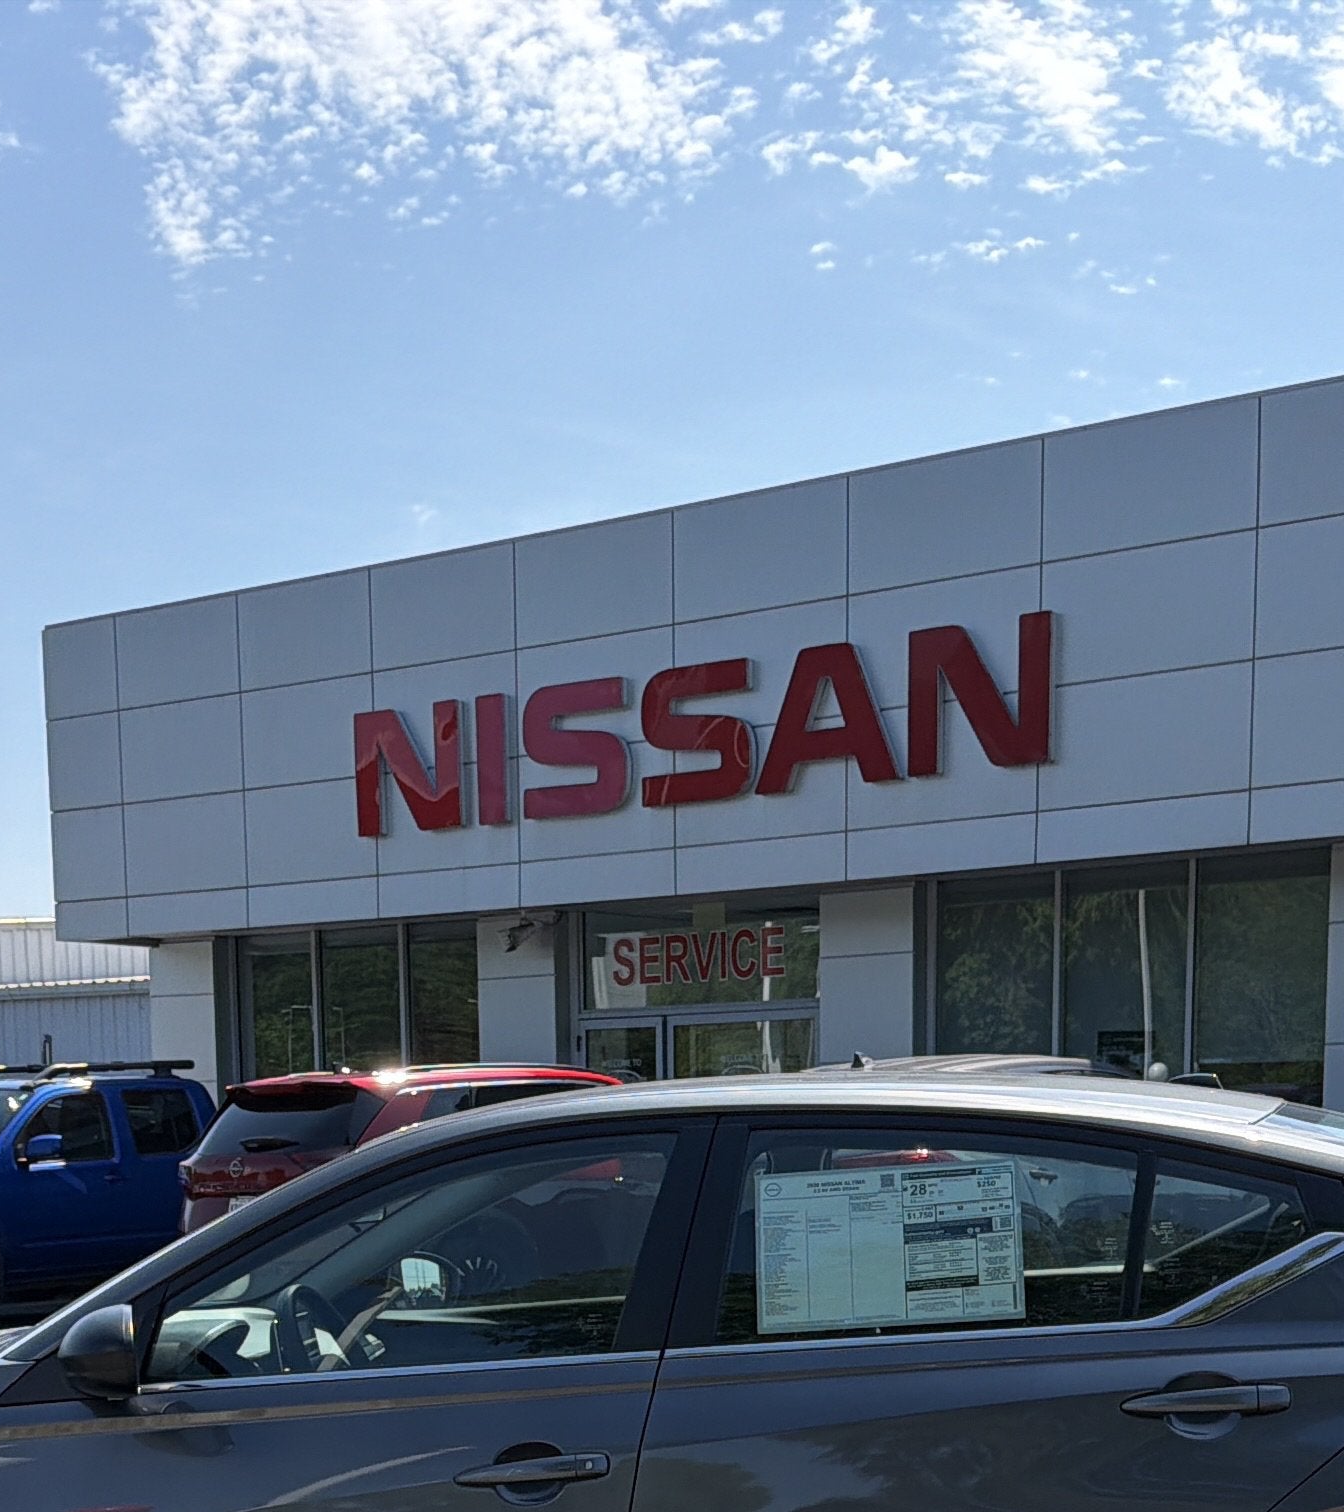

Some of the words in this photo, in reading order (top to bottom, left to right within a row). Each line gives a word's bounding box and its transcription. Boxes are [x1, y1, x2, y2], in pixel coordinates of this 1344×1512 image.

[353, 610, 1056, 838] NISSAN
[612, 925, 786, 987] SERVICE
[909, 1183, 927, 1196] 28
